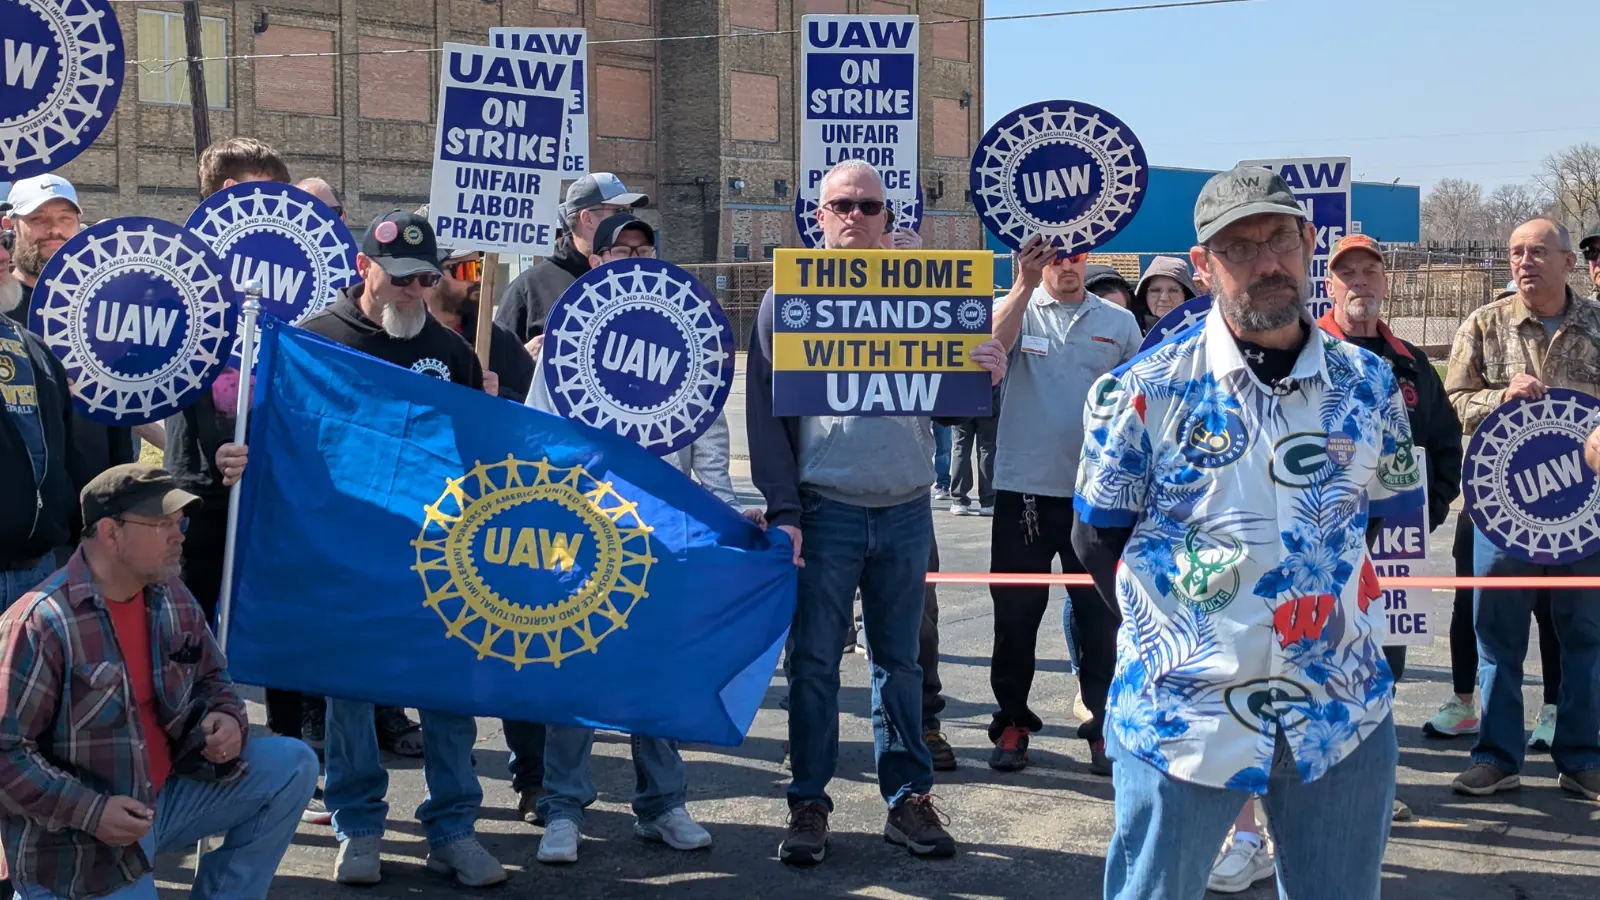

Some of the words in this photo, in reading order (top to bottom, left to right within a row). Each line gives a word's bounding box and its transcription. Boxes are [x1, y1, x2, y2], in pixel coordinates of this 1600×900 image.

[49, 5, 77, 52] IMPLEMENT
[808, 22, 914, 48] UAW
[496, 34, 582, 55] UAW
[61, 56, 78, 97] WORKERS
[450, 52, 566, 91] UAW
[840, 58, 880, 84] ON
[53, 98, 65, 110] OF
[482, 97, 526, 128] ON
[810, 88, 910, 114] STRIKE
[17, 109, 55, 134] AMERICA
[822, 124, 898, 144] UNFAIR
[446, 127, 557, 163] STRIKE
[826, 147, 894, 166] LABOR
[456, 167, 541, 195] UNFAIR
[1022, 164, 1091, 204] UAW
[1277, 163, 1346, 188] AW
[457, 193, 534, 219] LABOR
[243, 216, 259, 226] AND
[261, 217, 309, 240] AGRICULTURAL
[436, 216, 550, 245] PRACTICE
[212, 222, 241, 250] AEROSPACE
[108, 257, 124, 268] AND
[127, 256, 179, 276] AGRICULTURAL
[307, 238, 327, 275] IMPLEMENT
[74, 265, 106, 300] AEROSPACE
[230, 254, 306, 304] UAW
[796, 258, 868, 288] THIS
[882, 259, 972, 288] HOME
[178, 273, 202, 312] IMPLEMENT
[314, 279, 327, 311] WORKERS
[621, 294, 637, 302] AND
[588, 298, 620, 328] AEROSPACE
[641, 294, 686, 320] AGRICULTURAL
[816, 300, 952, 328] STANDS
[96, 300, 179, 347] UAW
[189, 315, 201, 350] WORKERS
[684, 318, 701, 358] IMPLEMENT
[78, 353, 100, 377] UNITED
[182, 351, 192, 362] OF
[602, 331, 681, 385] UAW
[803, 340, 890, 366] WITH
[899, 340, 964, 366] THE
[153, 362, 183, 384] AMERICA
[687, 361, 701, 392] WORKERS
[584, 377, 601, 403] UNITED
[826, 373, 942, 412] UAW
[652, 403, 680, 420] AMERICA
[1202, 433, 1244, 465] BREWERS
[1514, 450, 1582, 503] UAW
[479, 500, 493, 512] OF
[493, 490, 539, 505] AMERICA
[544, 487, 580, 504] UNITED
[484, 528, 584, 572] UAW
[1372, 526, 1421, 554] IKE
[453, 547, 480, 597] IMPLEMENT
[580, 557, 615, 608] AEROSPACE
[476, 595, 556, 624] AGRICULTURAL
[557, 604, 582, 620] AND
[1201, 590, 1230, 612] BUCKS
[1273, 594, 1336, 650] W
